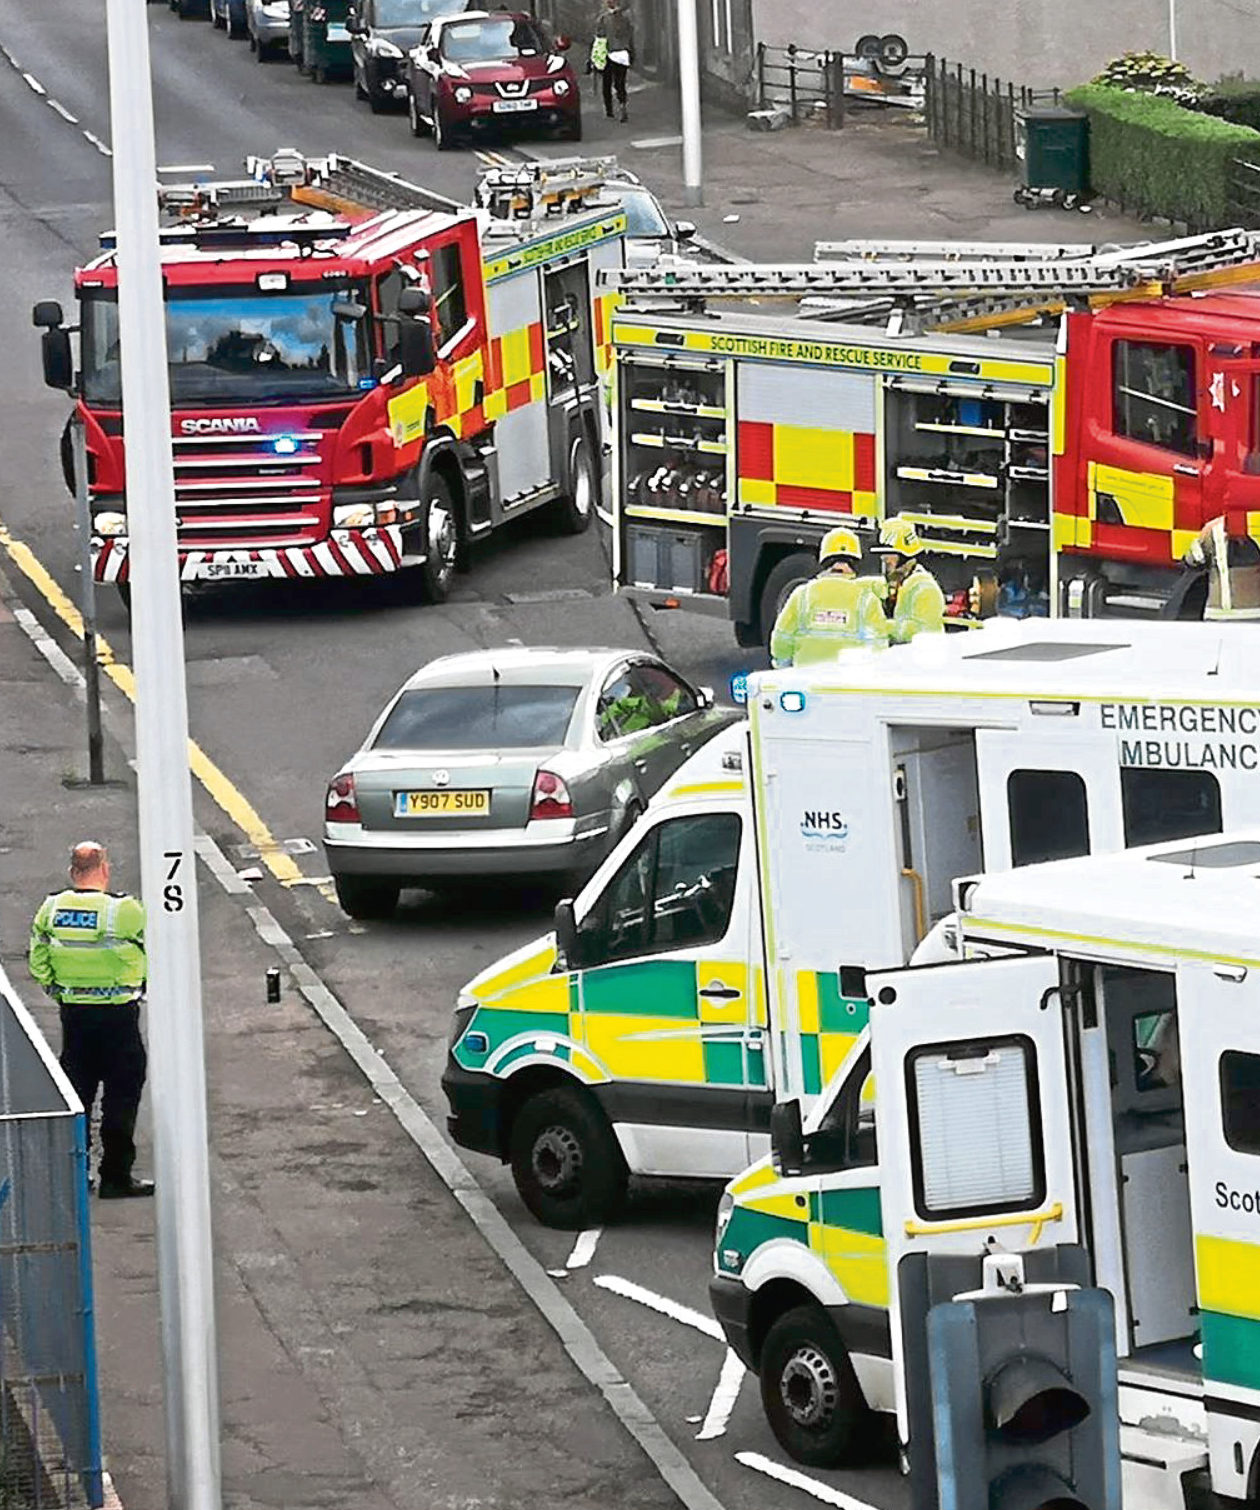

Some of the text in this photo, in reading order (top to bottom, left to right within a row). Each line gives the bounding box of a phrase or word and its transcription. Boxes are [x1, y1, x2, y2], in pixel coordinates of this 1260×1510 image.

[711, 336, 921, 370] SCOTTISH FIRE AND RESCUE SERVICE
[180, 417, 261, 434] SCANIA
[410, 793, 485, 809] Y907 SUD
[805, 811, 842, 829] NHS
[55, 910, 97, 927] POLICE
